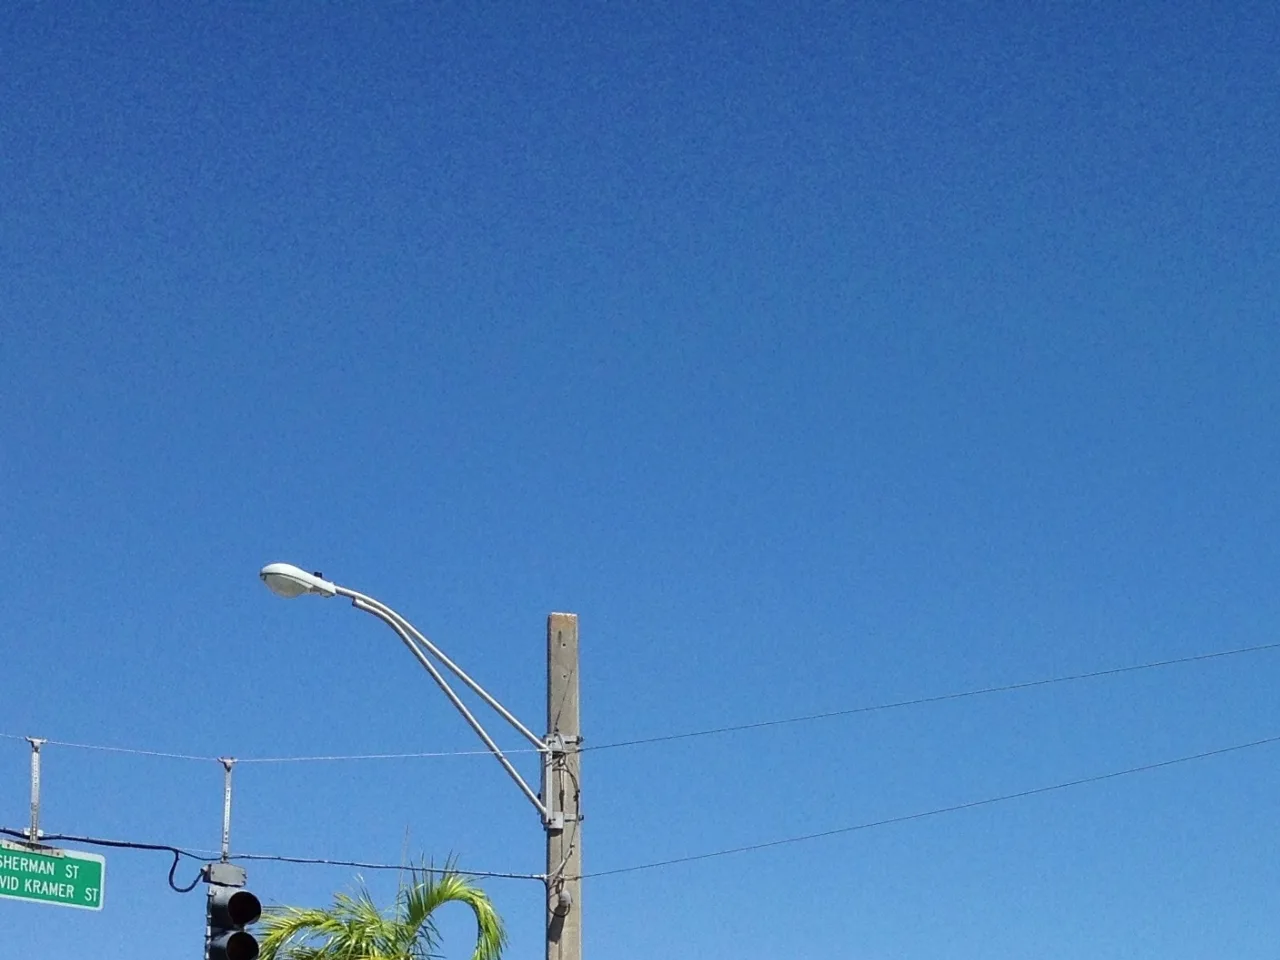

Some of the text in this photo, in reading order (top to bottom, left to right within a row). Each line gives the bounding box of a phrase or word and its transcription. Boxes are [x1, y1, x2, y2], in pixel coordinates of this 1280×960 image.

[65, 864, 79, 880] ST
[24, 878, 75, 899] KRAMER
[84, 887, 99, 902] ST
